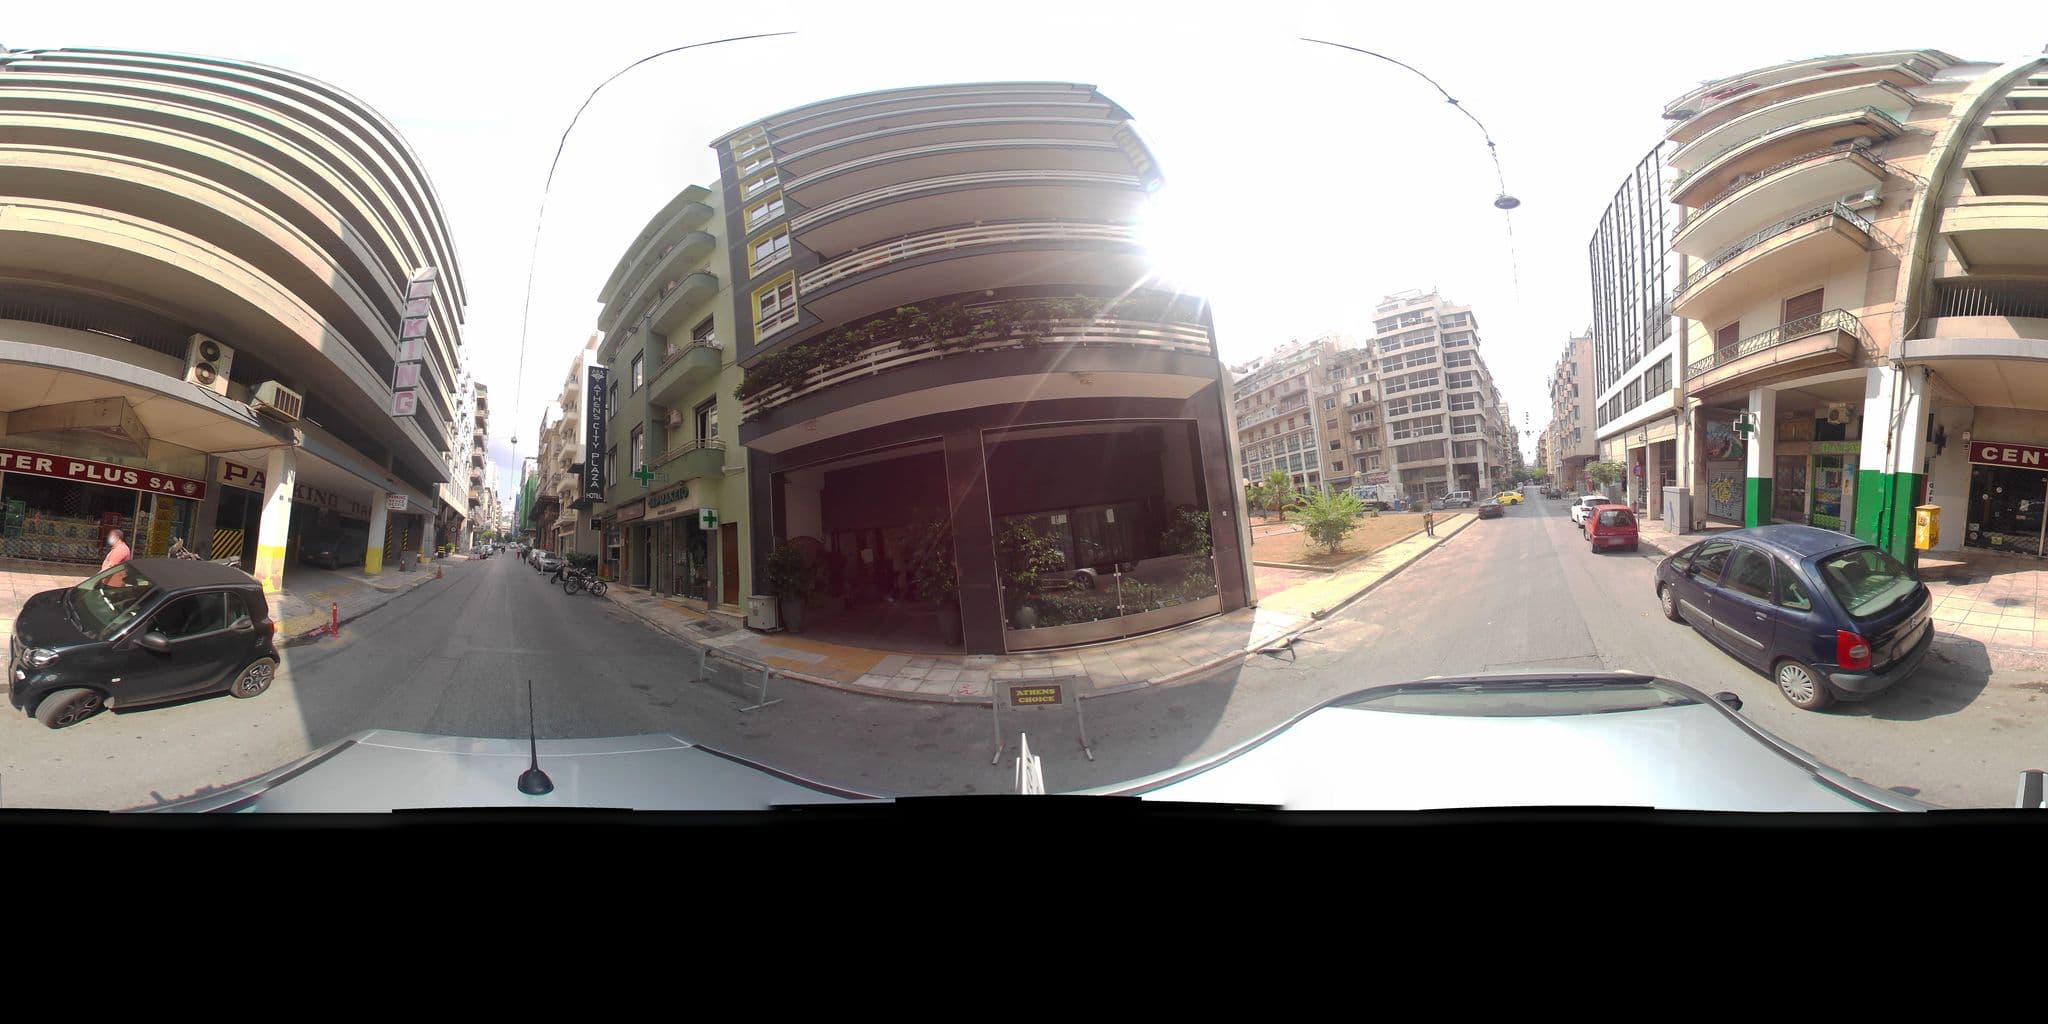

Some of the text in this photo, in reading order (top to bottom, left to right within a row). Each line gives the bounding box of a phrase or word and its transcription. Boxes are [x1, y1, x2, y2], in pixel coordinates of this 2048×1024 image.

[590, 385, 602, 488] ATHENS CITY PLAZA
[1981, 446, 2048, 465] CEN
[69, 461, 139, 485] PLUS
[149, 477, 175, 492] SA
[586, 492, 603, 500] HOTEL
[1016, 688, 1056, 696] ATHENS
[1018, 695, 1056, 703] CHOICE
